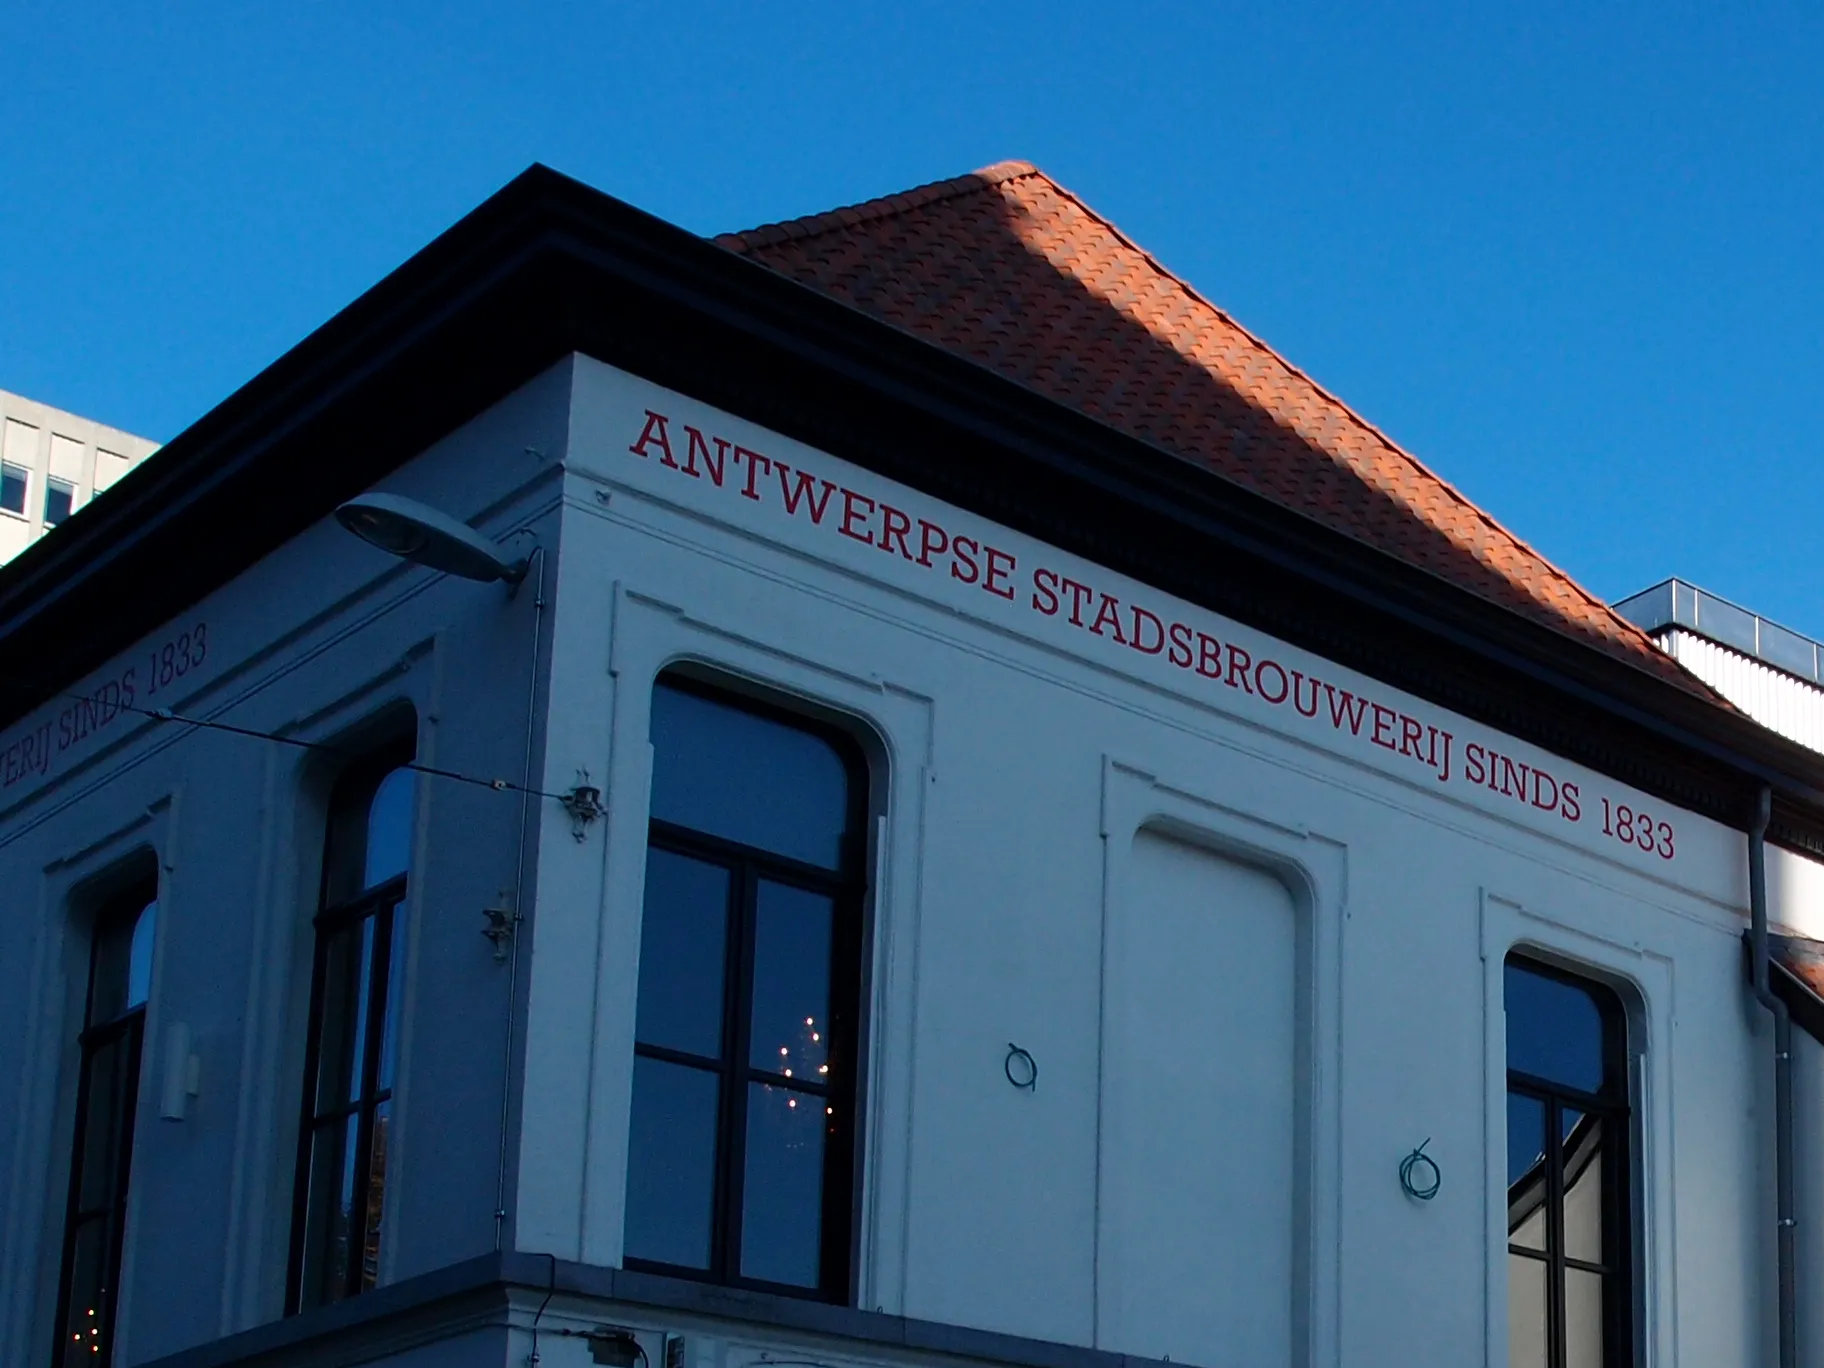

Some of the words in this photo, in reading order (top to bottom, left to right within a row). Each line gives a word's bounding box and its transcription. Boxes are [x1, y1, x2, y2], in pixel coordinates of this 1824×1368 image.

[0, 720, 53, 788] ERIJ
[58, 667, 136, 751] SINDS
[148, 622, 207, 695] 1833
[629, 410, 1017, 600] ANTWERPSE
[1032, 569, 1453, 781] STADSBROUWERIJ
[1465, 744, 1581, 822] SINDS
[1600, 797, 1675, 859] 1833
